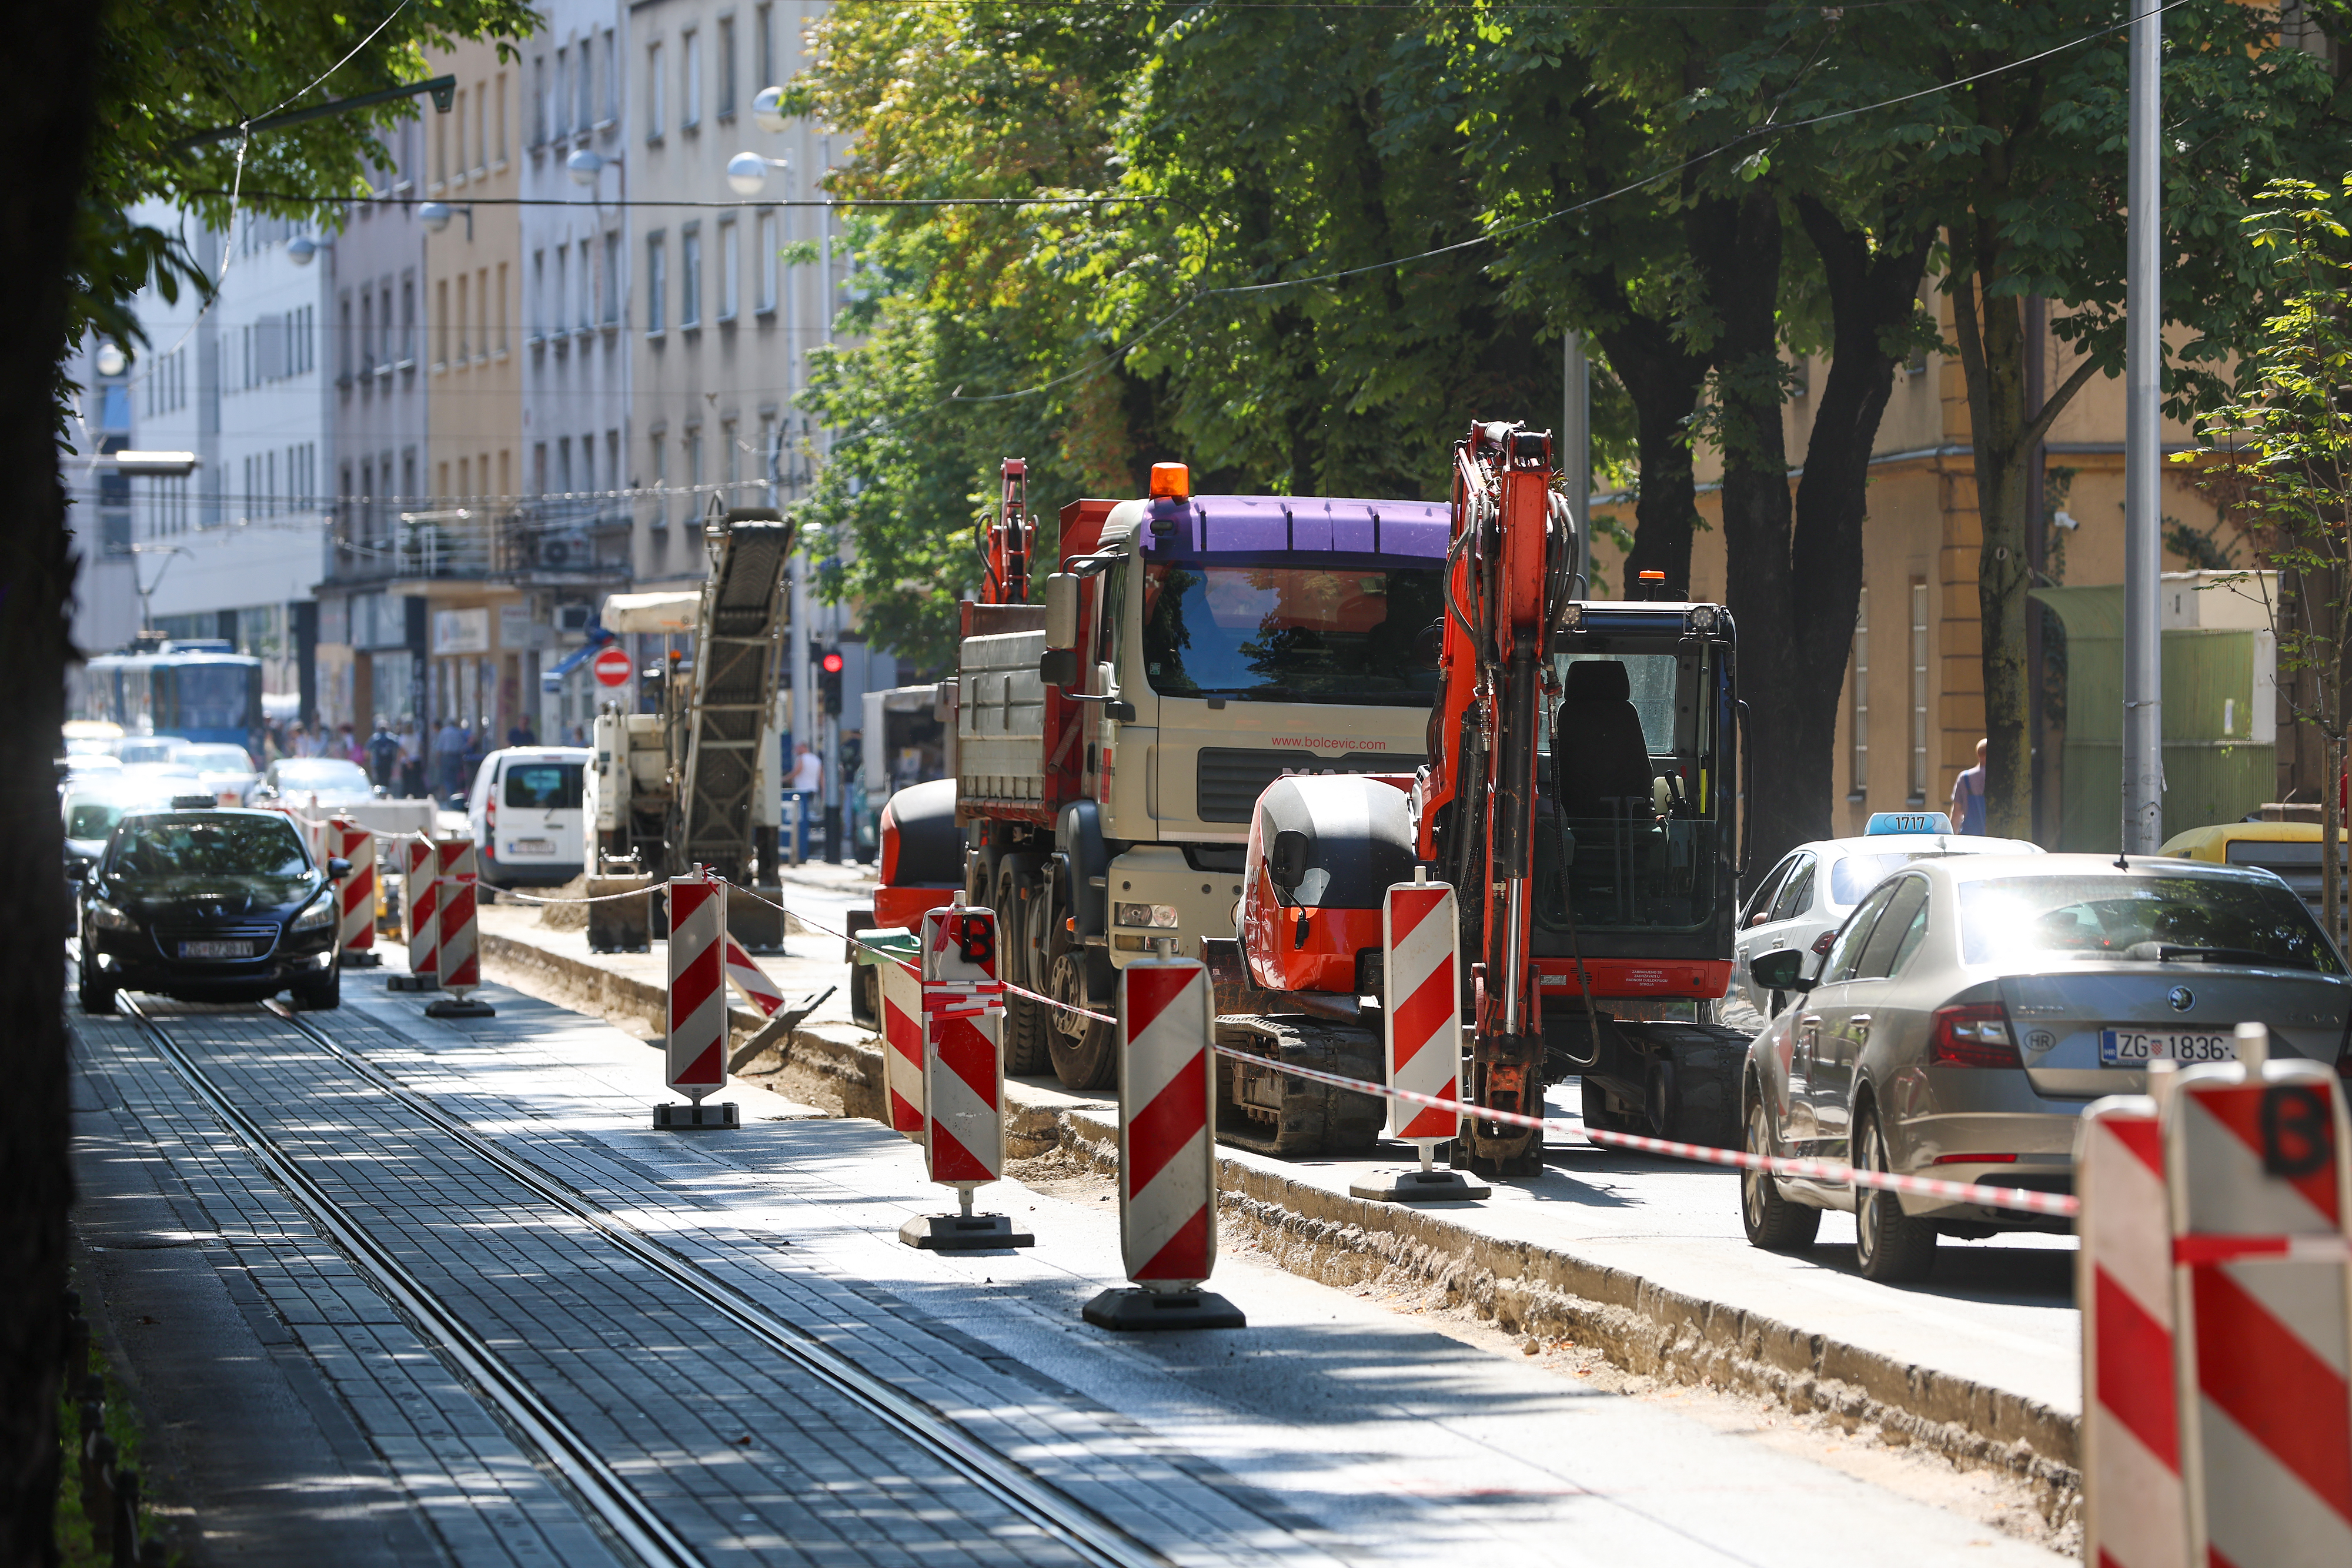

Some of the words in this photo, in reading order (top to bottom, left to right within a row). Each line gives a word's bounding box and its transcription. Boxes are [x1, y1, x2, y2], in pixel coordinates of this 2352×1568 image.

[1271, 736, 1386, 750] www.bolcevic.com
[1895, 816, 1925, 830] 1717
[960, 913, 994, 964] B
[2030, 1035, 2050, 1047] HR
[2120, 1034, 2147, 1058] ZG
[2262, 1084, 2330, 1178] B
